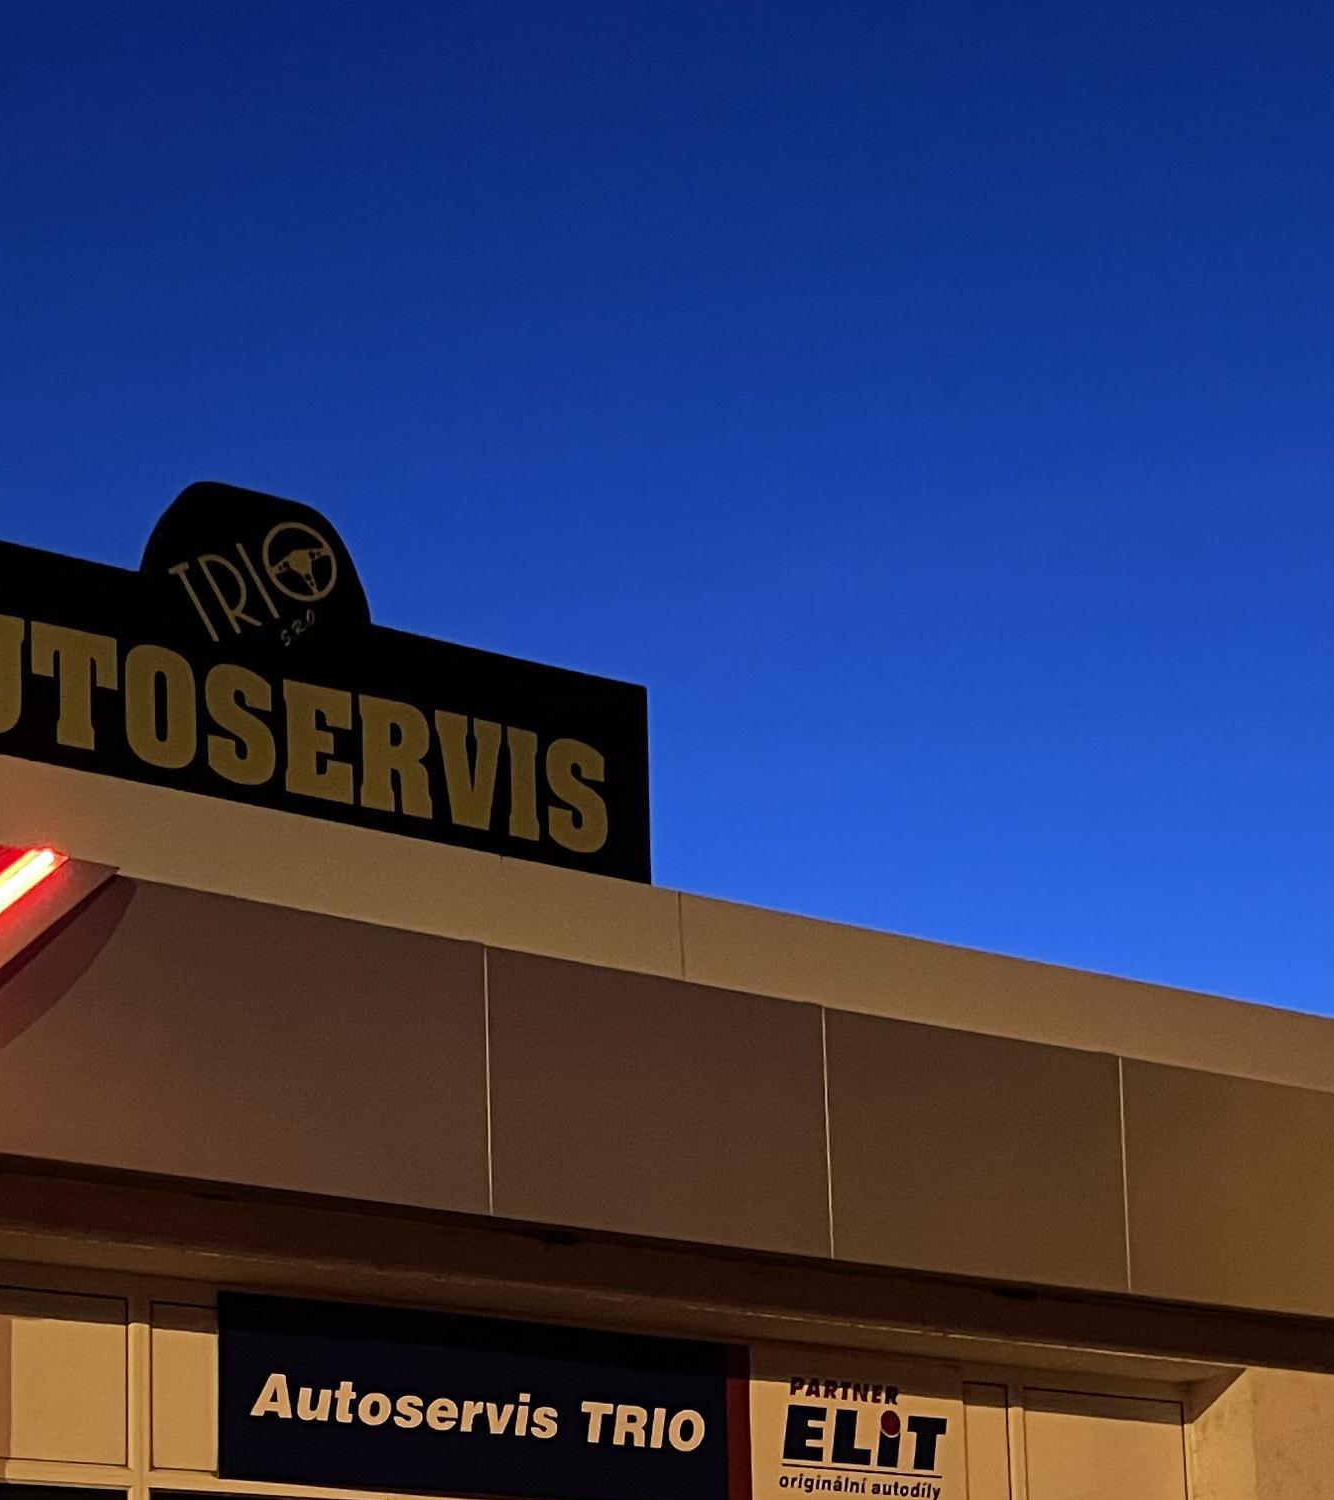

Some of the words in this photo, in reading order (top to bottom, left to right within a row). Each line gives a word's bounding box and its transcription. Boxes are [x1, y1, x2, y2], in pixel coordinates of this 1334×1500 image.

[168, 521, 337, 642] TRIO
[251, 1373, 557, 1439] Autoservis
[581, 1401, 705, 1453] TRIO
[790, 1376, 899, 1405] PARTNER
[779, 1473, 867, 1494] originální
